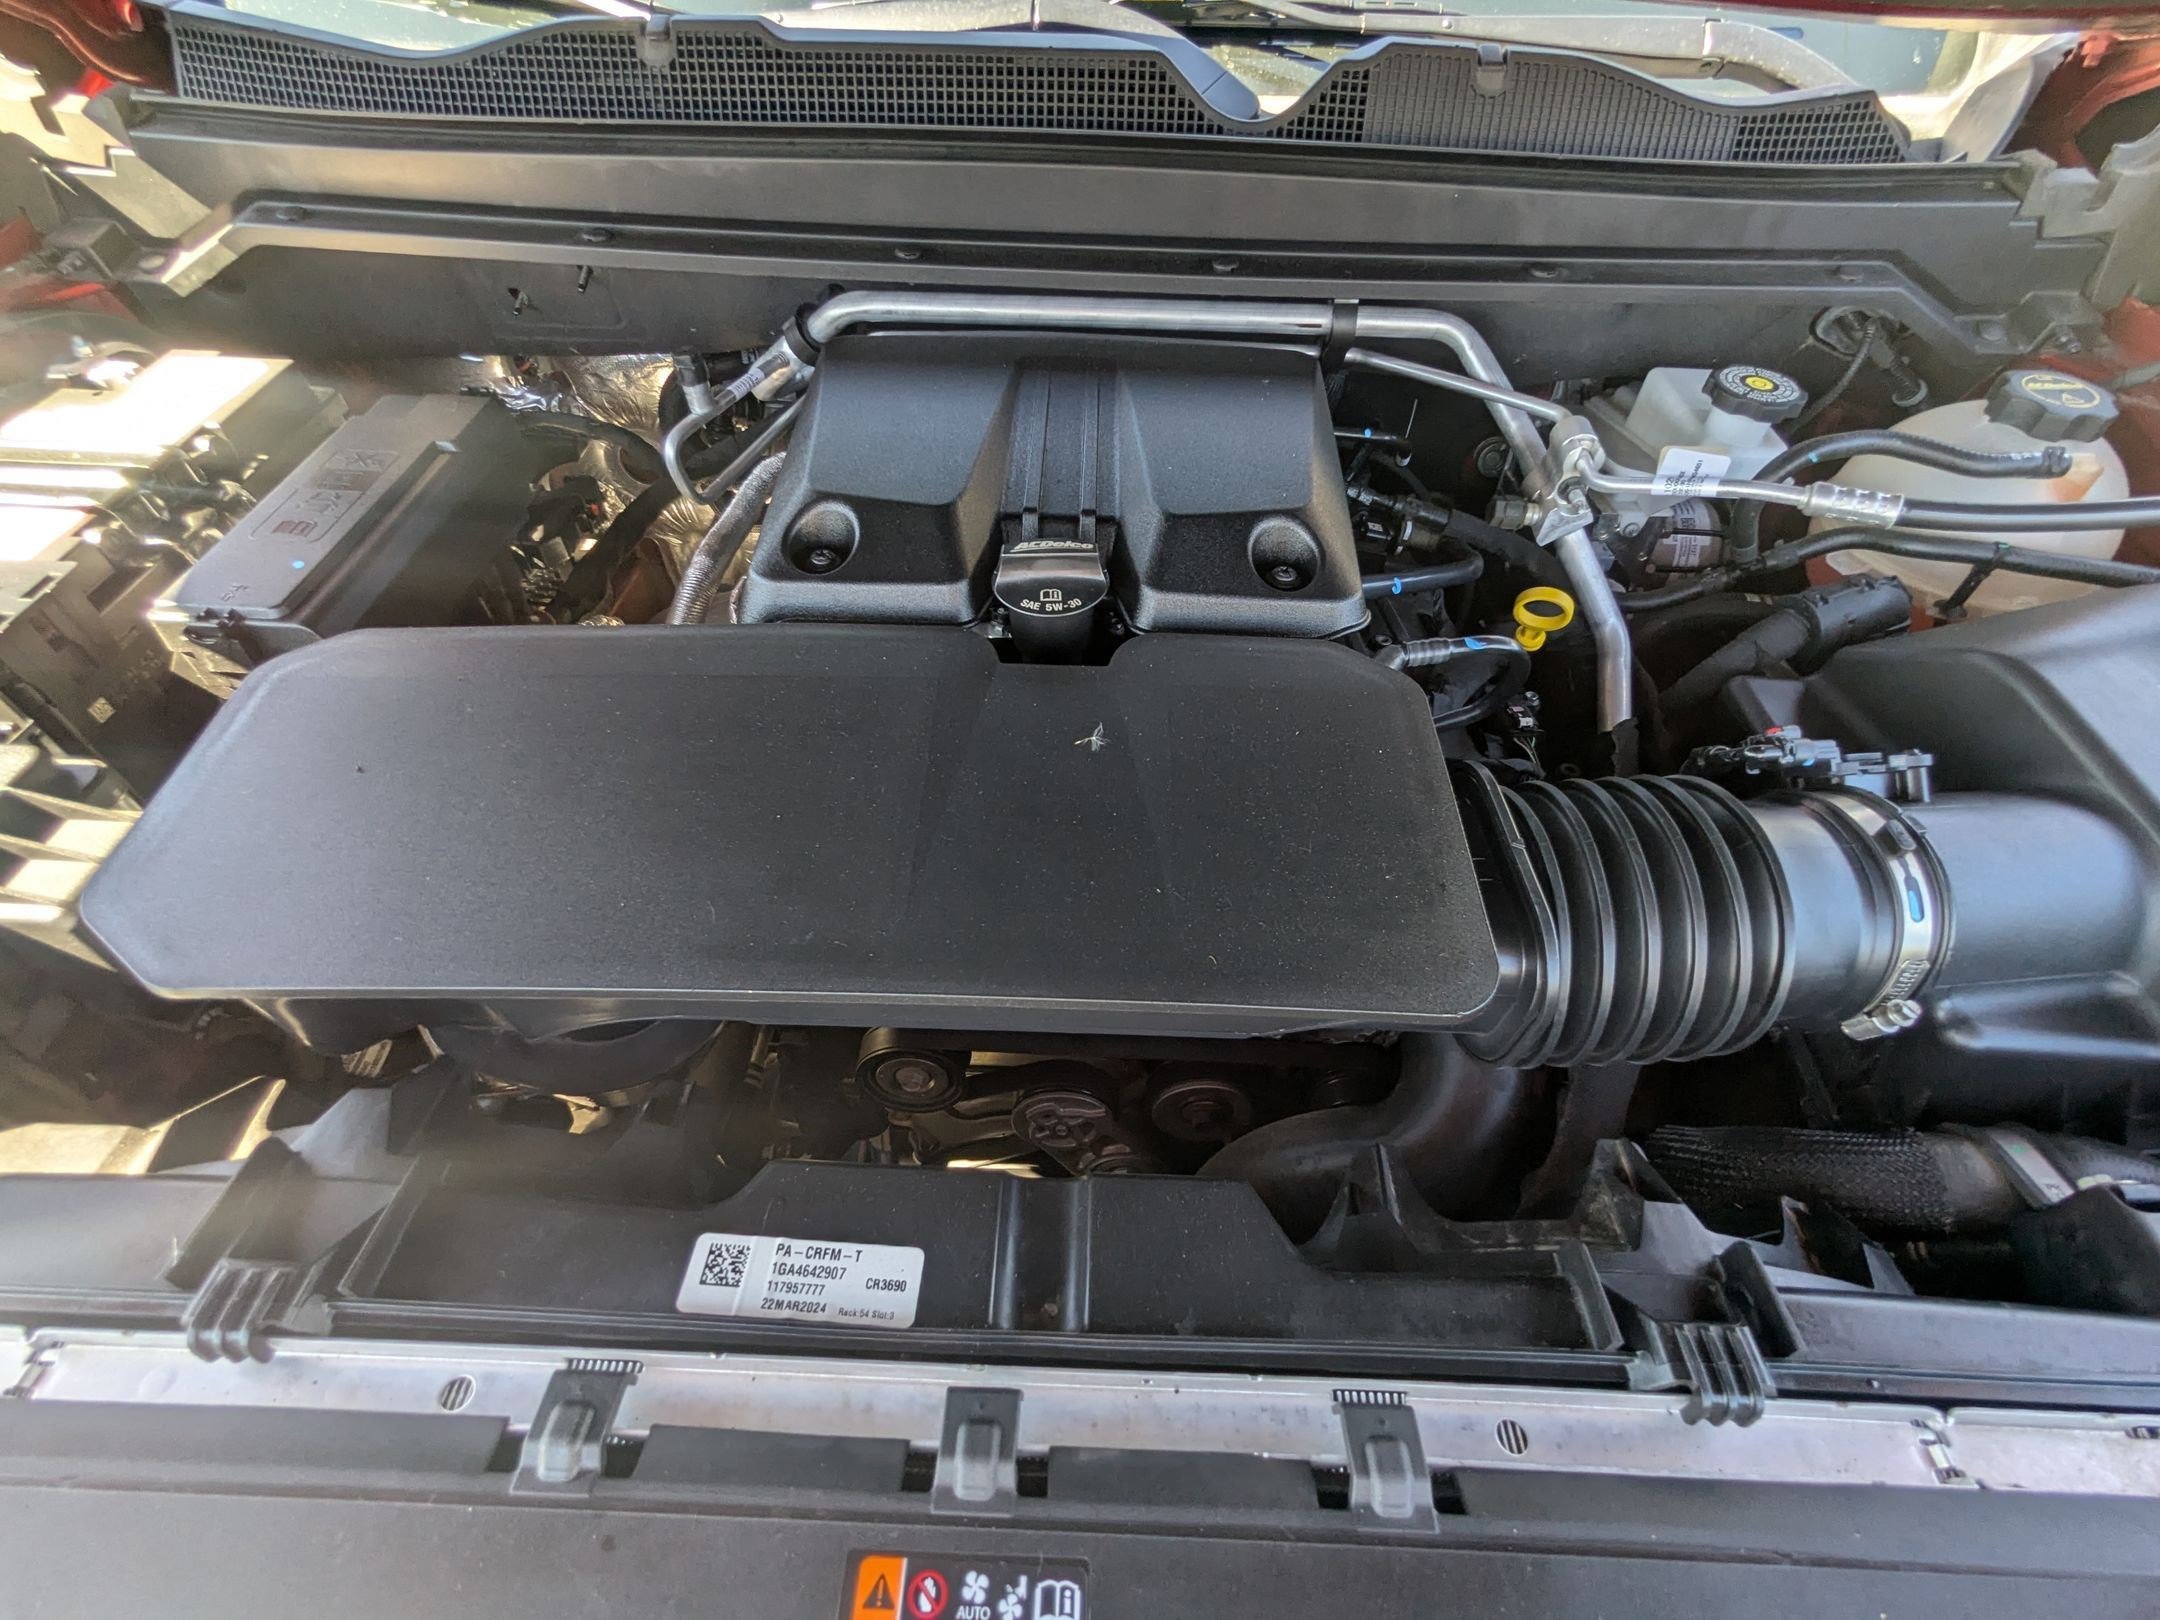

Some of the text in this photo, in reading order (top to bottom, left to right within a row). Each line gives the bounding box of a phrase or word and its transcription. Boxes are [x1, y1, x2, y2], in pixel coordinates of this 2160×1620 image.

[1020, 598, 1082, 611] SAE 5W-30
[771, 1261, 847, 1280] 1GA4642907
[767, 1280, 826, 1296] 117957777
[865, 1277, 907, 1292] CR3690
[760, 1297, 827, 1314] 22MAR2024
[956, 1605, 991, 1620] AUTO
